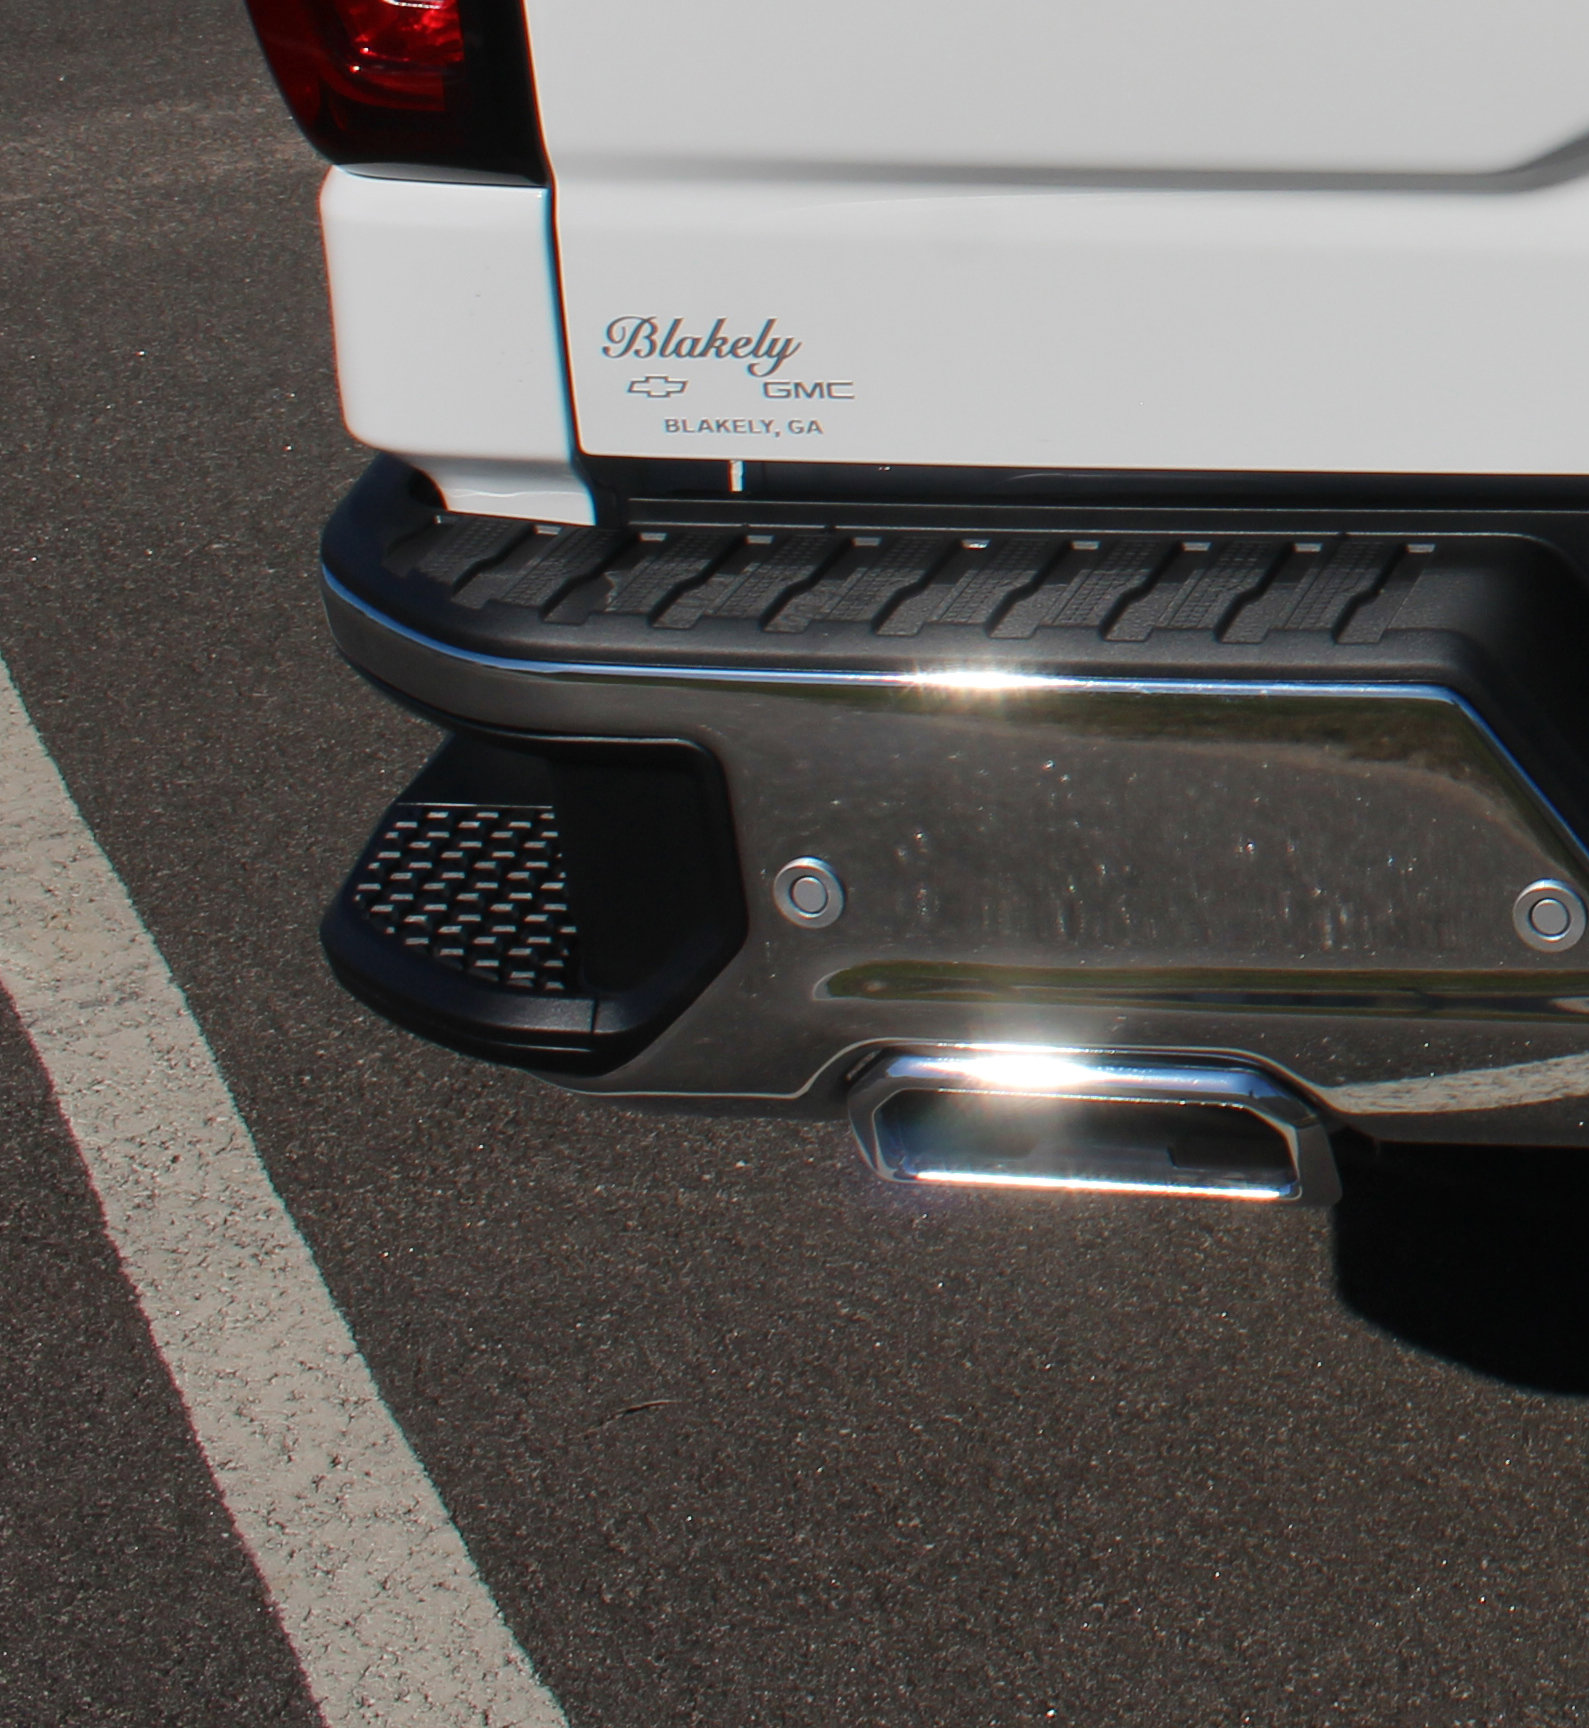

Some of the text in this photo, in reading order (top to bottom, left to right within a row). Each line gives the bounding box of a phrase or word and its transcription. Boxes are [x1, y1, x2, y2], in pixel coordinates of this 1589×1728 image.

[602, 315, 802, 377] Blakely
[763, 380, 856, 400] GMC
[665, 419, 825, 438] BLAKELY, GA
